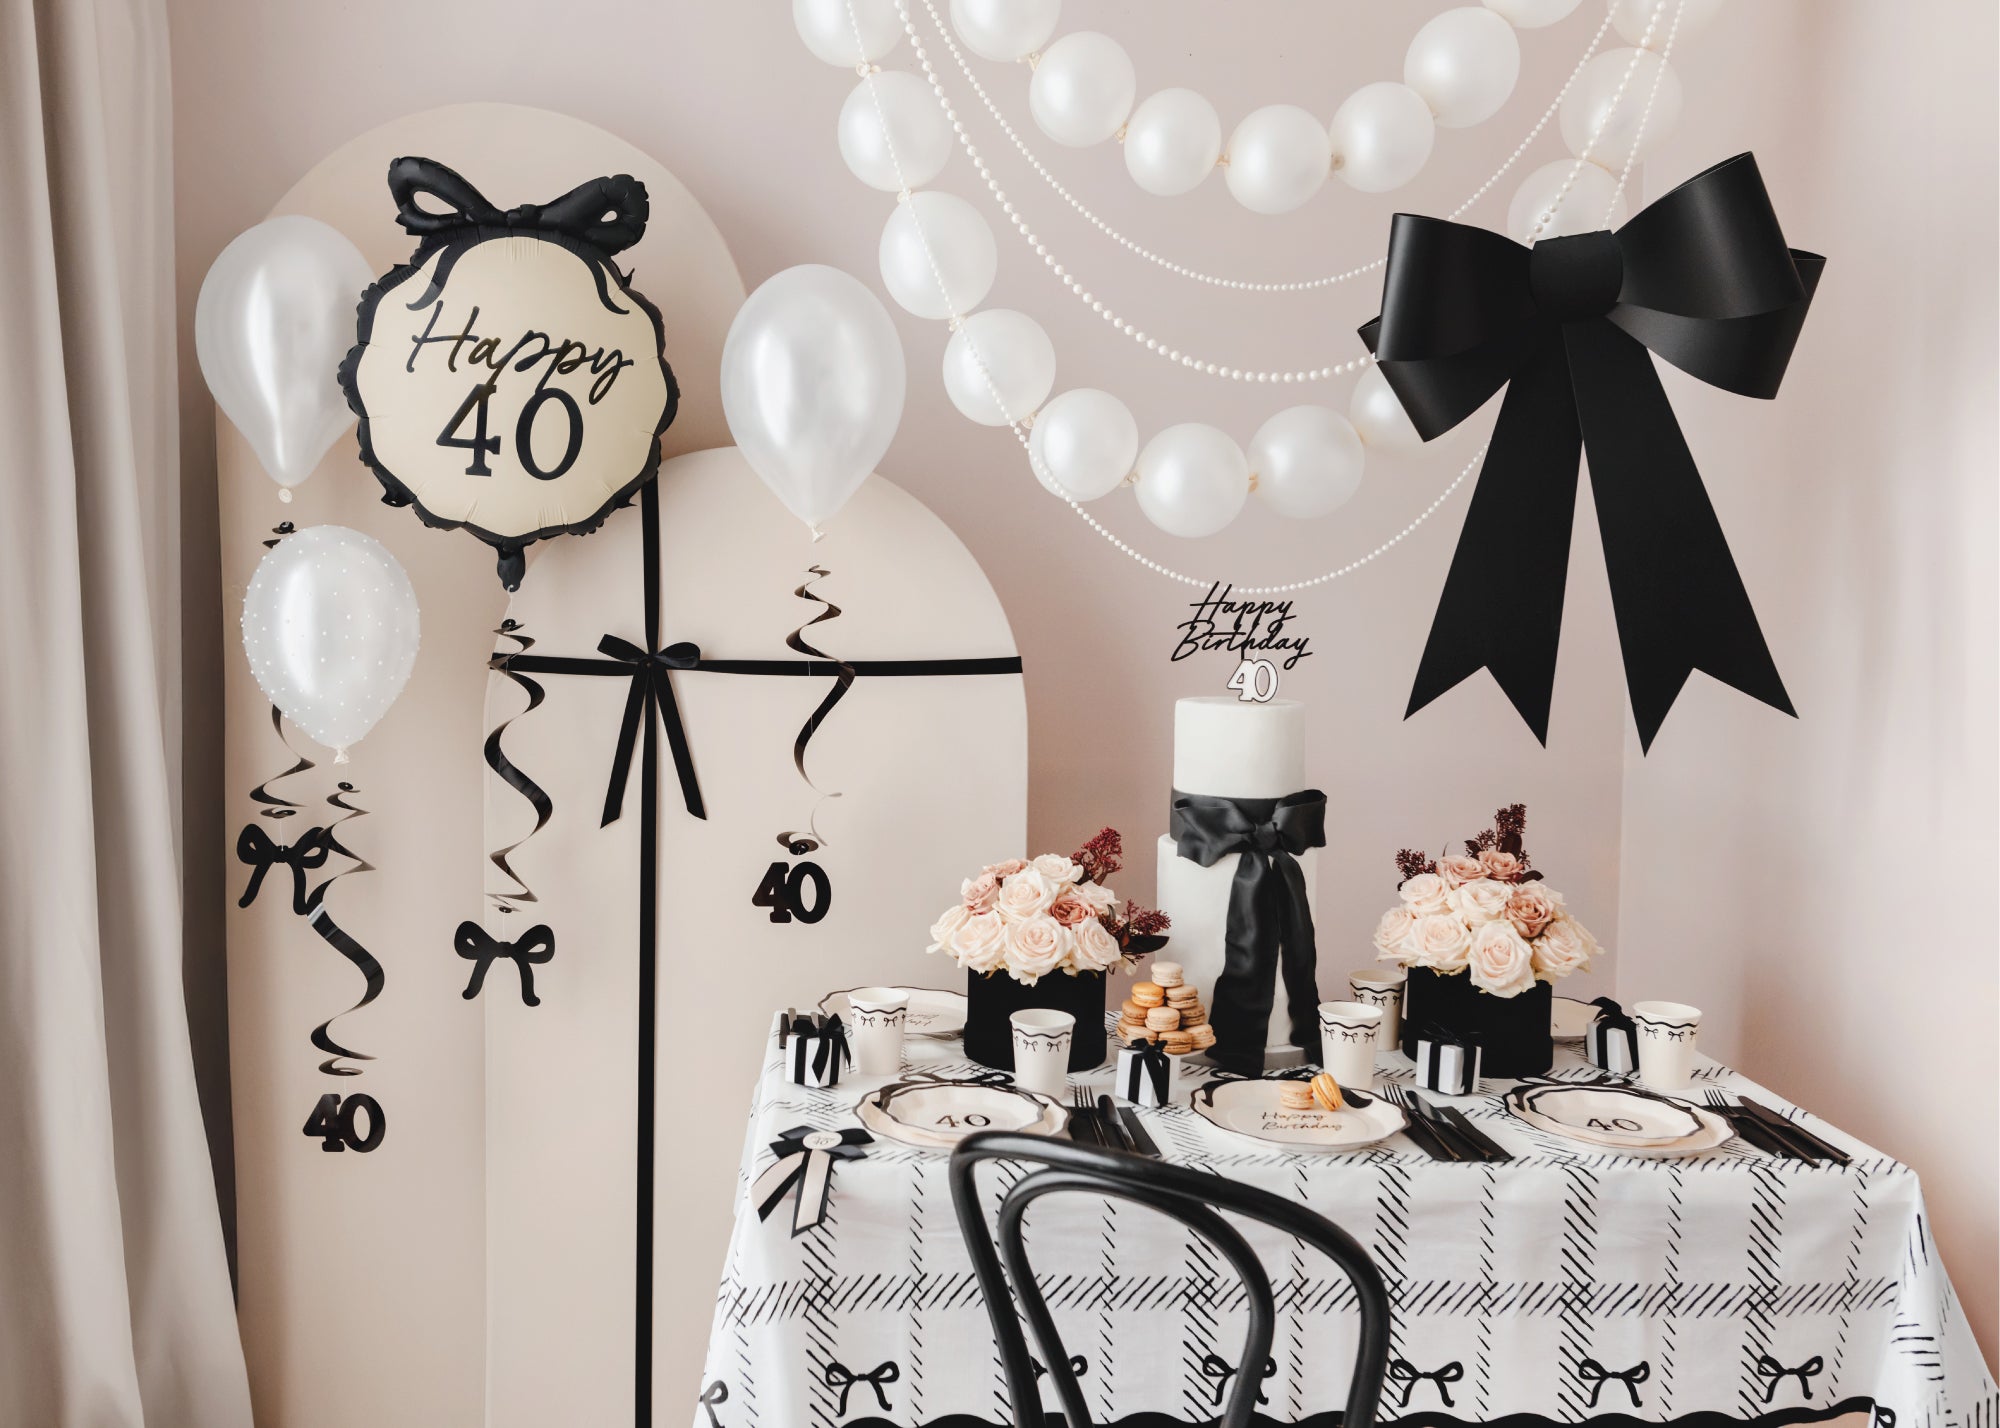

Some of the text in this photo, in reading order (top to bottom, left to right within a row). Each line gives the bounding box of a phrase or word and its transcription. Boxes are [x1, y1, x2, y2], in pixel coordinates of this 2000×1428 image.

[407, 301, 634, 405] Happy
[436, 383, 584, 481] 40
[1190, 581, 1297, 634] Happy
[1171, 619, 1313, 670] Birthday
[1227, 659, 1278, 703] 40
[752, 861, 832, 924] 40
[303, 1093, 386, 1153] 40
[936, 1114, 991, 1127] 40
[1587, 1118, 1643, 1131] 40
